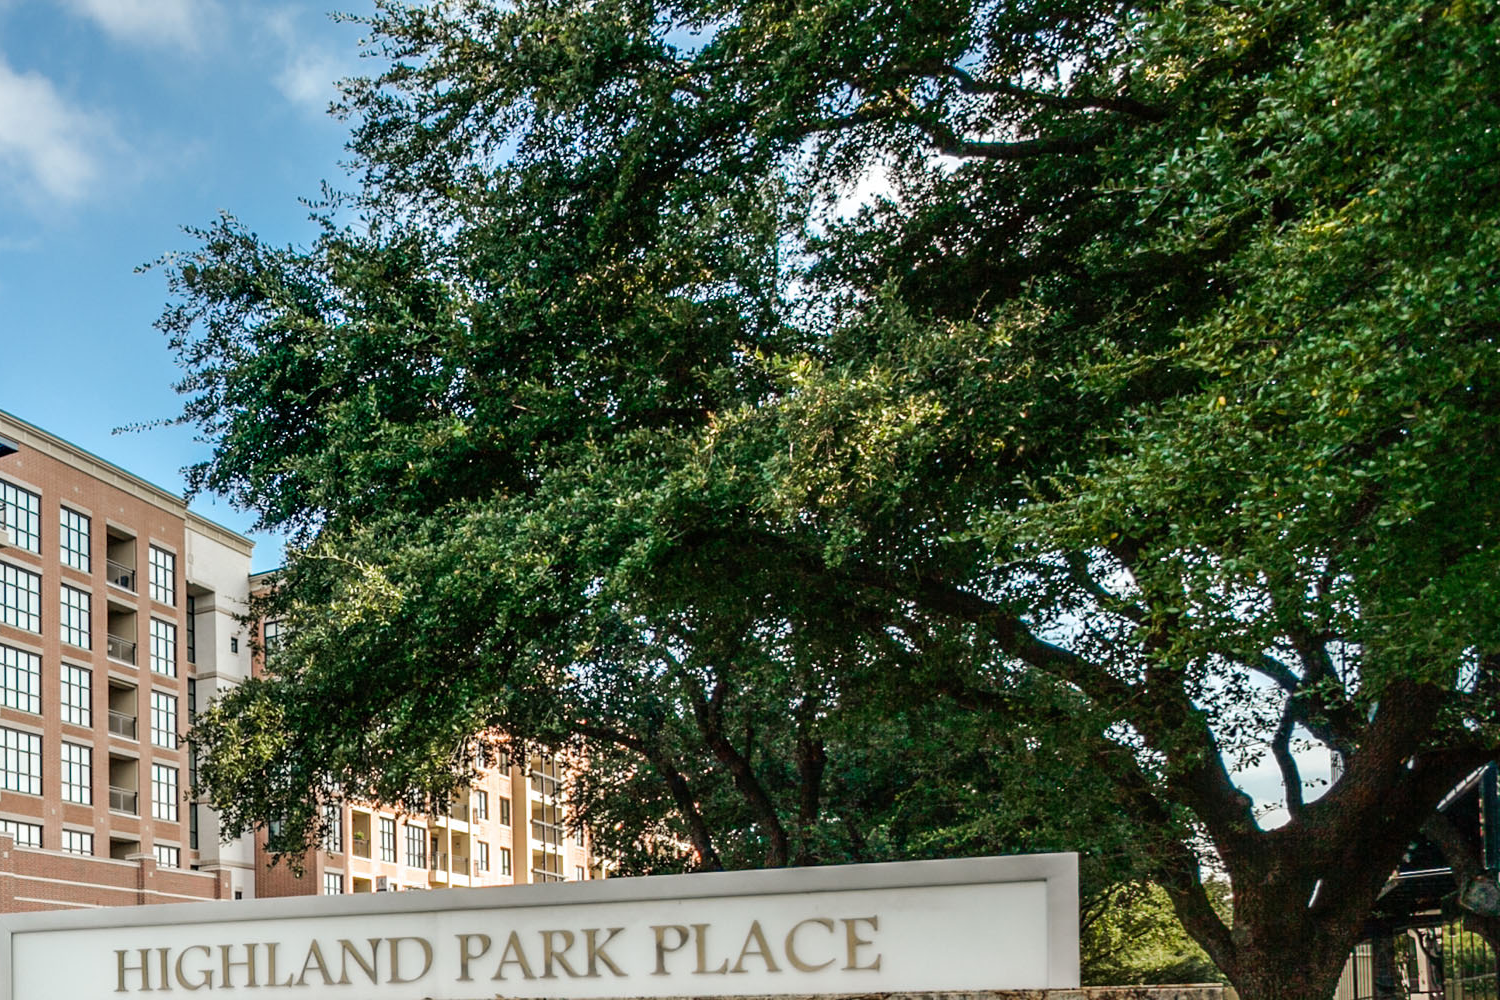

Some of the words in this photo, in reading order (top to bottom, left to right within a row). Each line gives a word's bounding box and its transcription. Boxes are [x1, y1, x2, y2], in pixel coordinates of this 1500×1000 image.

[113, 936, 434, 993] HIGHLAND
[454, 926, 628, 982] PARK
[649, 915, 882, 977] PLACE
